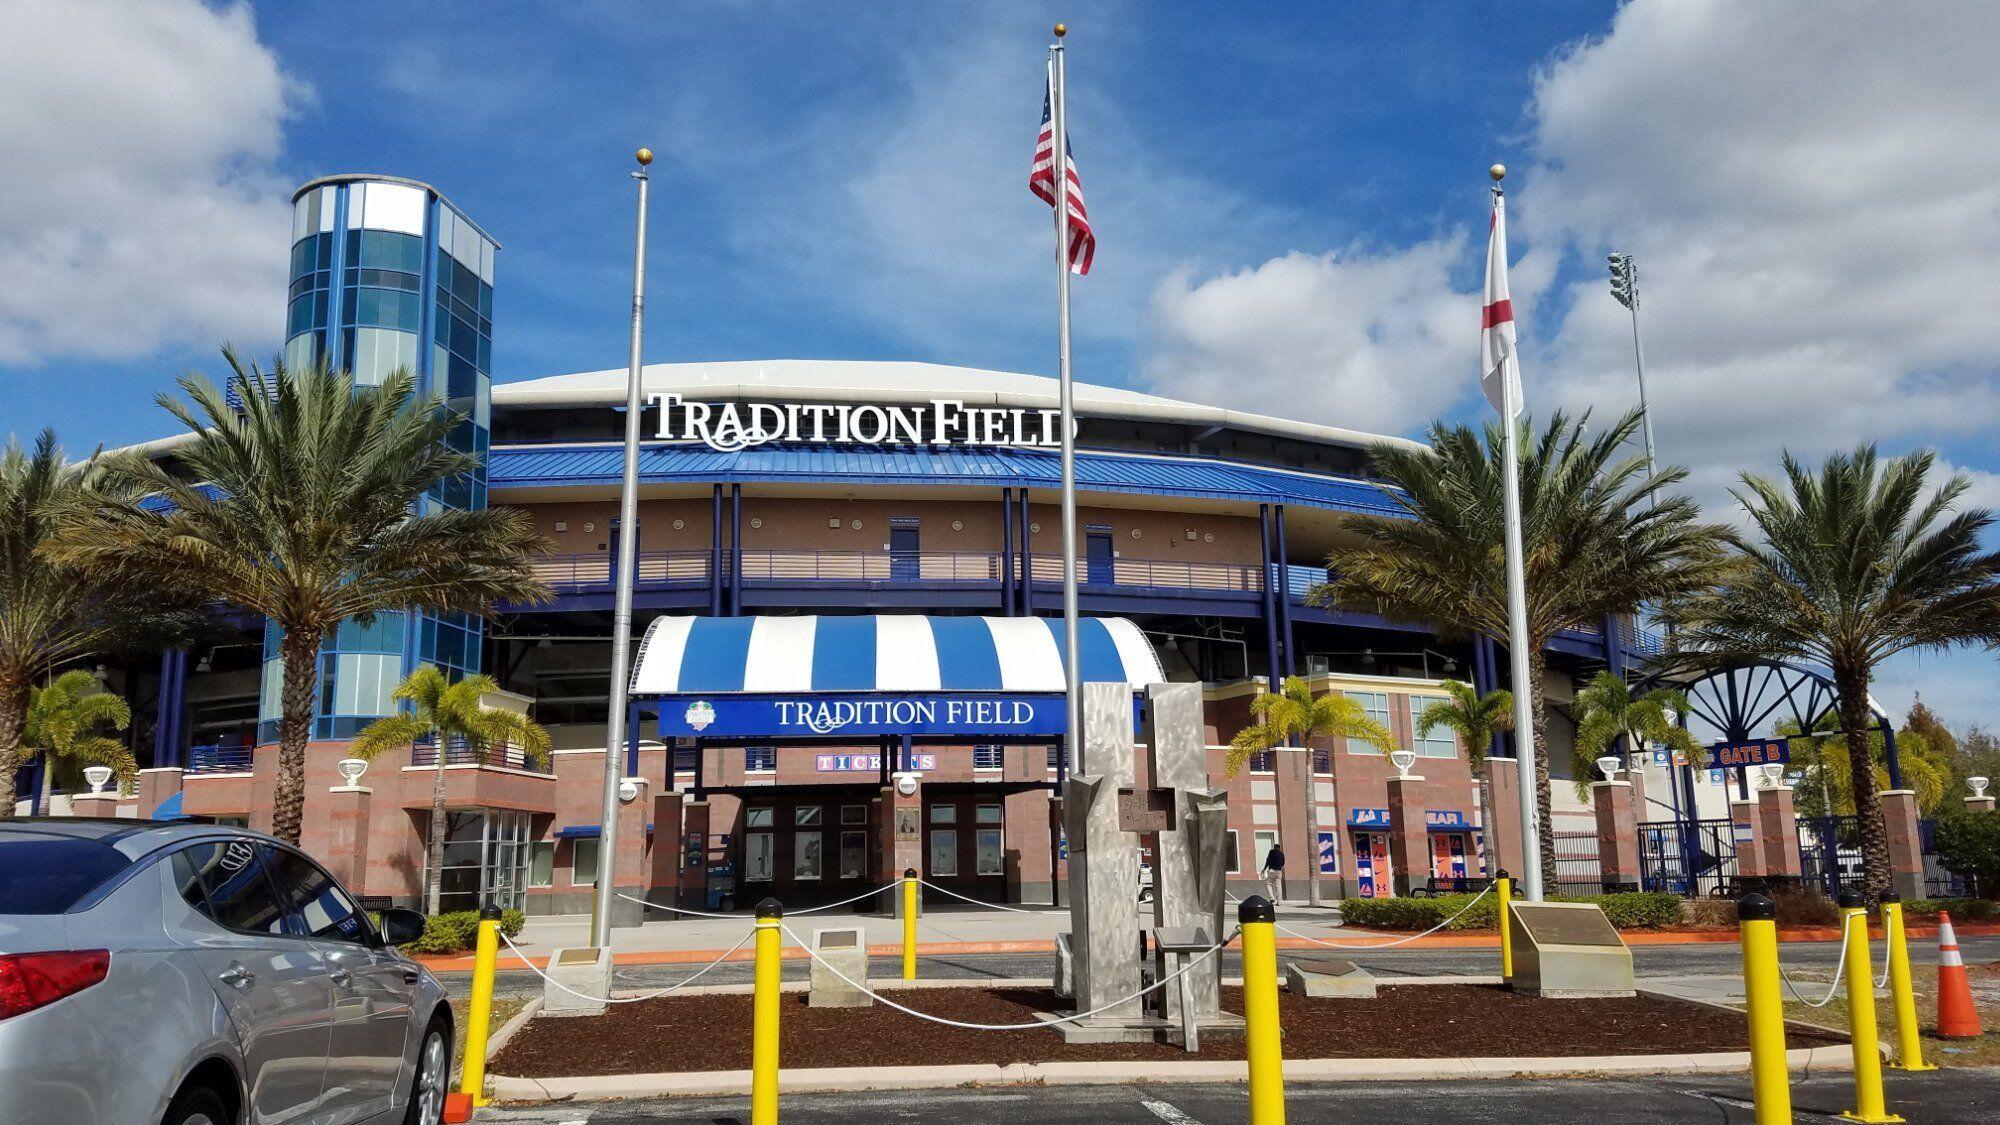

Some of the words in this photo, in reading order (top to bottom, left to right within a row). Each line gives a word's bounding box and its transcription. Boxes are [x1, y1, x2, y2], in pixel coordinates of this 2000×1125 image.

[647, 392, 925, 452] TRADITION
[929, 399, 1079, 447] FIELD
[774, 701, 937, 734] TRADITION
[946, 701, 1035, 725] FIELD
[1719, 744, 1763, 765] GATE
[1767, 743, 1780, 762] B
